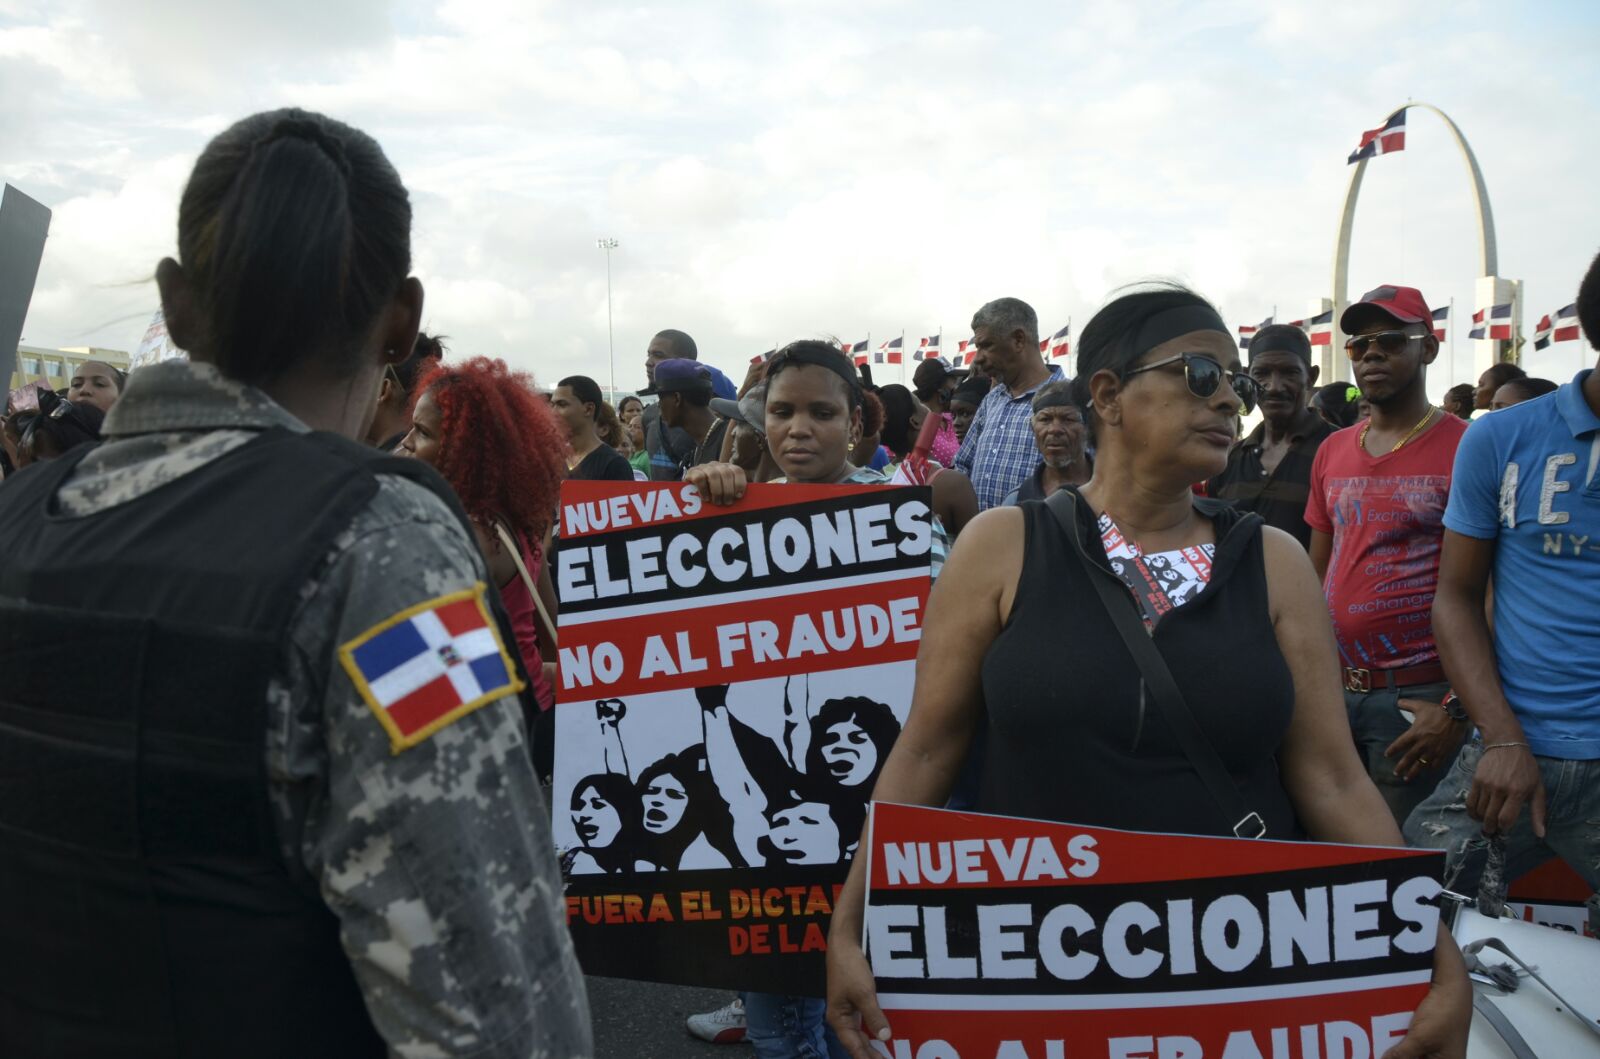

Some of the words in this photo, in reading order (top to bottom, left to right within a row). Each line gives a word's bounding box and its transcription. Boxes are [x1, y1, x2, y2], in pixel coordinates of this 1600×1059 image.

[564, 484, 703, 536] NUEVAS
[557, 500, 932, 603] ELECCIONES
[1348, 592, 1435, 615] exchange
[558, 642, 624, 690] NO
[638, 630, 708, 680] AL
[716, 596, 922, 668] FRAUDE
[883, 834, 1100, 885] NUEVAS
[566, 892, 675, 925] FUERA
[680, 890, 723, 921] EL
[867, 875, 1443, 981] ELECCIONES
[728, 923, 773, 956] DE
[778, 922, 828, 954] LA
